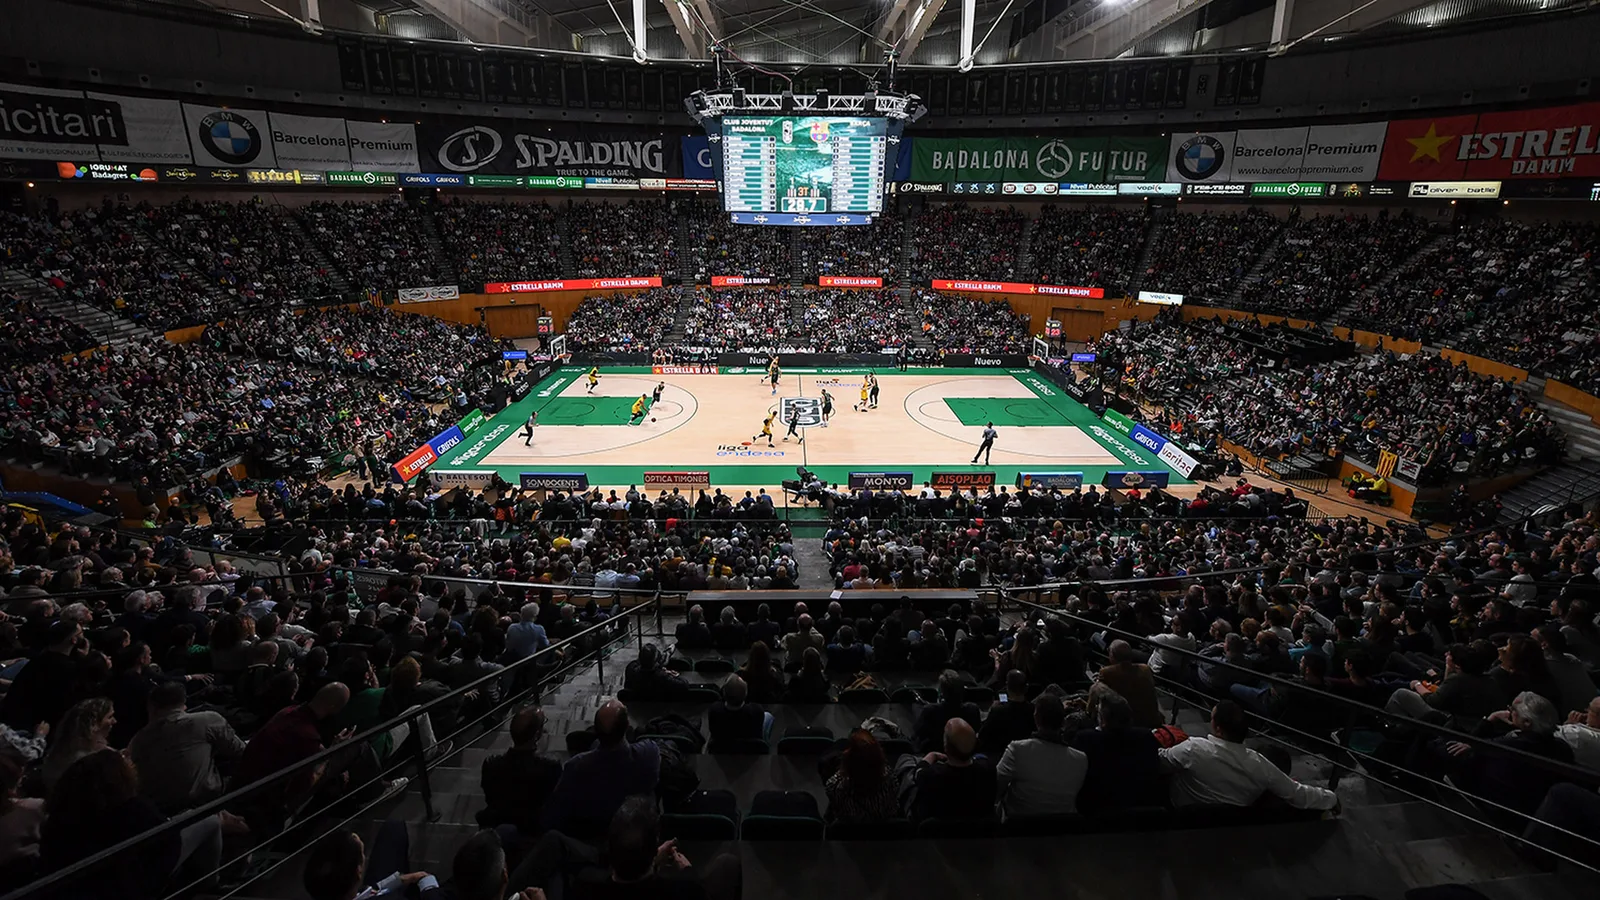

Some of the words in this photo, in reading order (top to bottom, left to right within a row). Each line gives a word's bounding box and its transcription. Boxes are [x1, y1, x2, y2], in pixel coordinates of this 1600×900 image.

[202, 112, 253, 131] BMW
[274, 131, 346, 147] Barcelona
[350, 139, 412, 151] Premium
[1183, 136, 1222, 150] BMW
[1234, 144, 1303, 157] Barcelona
[1308, 142, 1378, 155] Premium
[514, 134, 663, 173] SPALDING
[932, 150, 1029, 170] BADALONA
[1079, 151, 1148, 170] FUTUR
[1238, 164, 1364, 176] www.barcelonapremium.es
[1512, 157, 1575, 174] DAMM
[330, 174, 363, 182] BADALONA
[511, 283, 542, 291] ESTRELLA
[1038, 287, 1068, 295] ESTRELLA
[974, 357, 1001, 365] Nuevo
[437, 436, 460, 454] GRIFOLS
[1134, 432, 1158, 450] GRIFOLS
[409, 452, 433, 471] ESTRELLA
